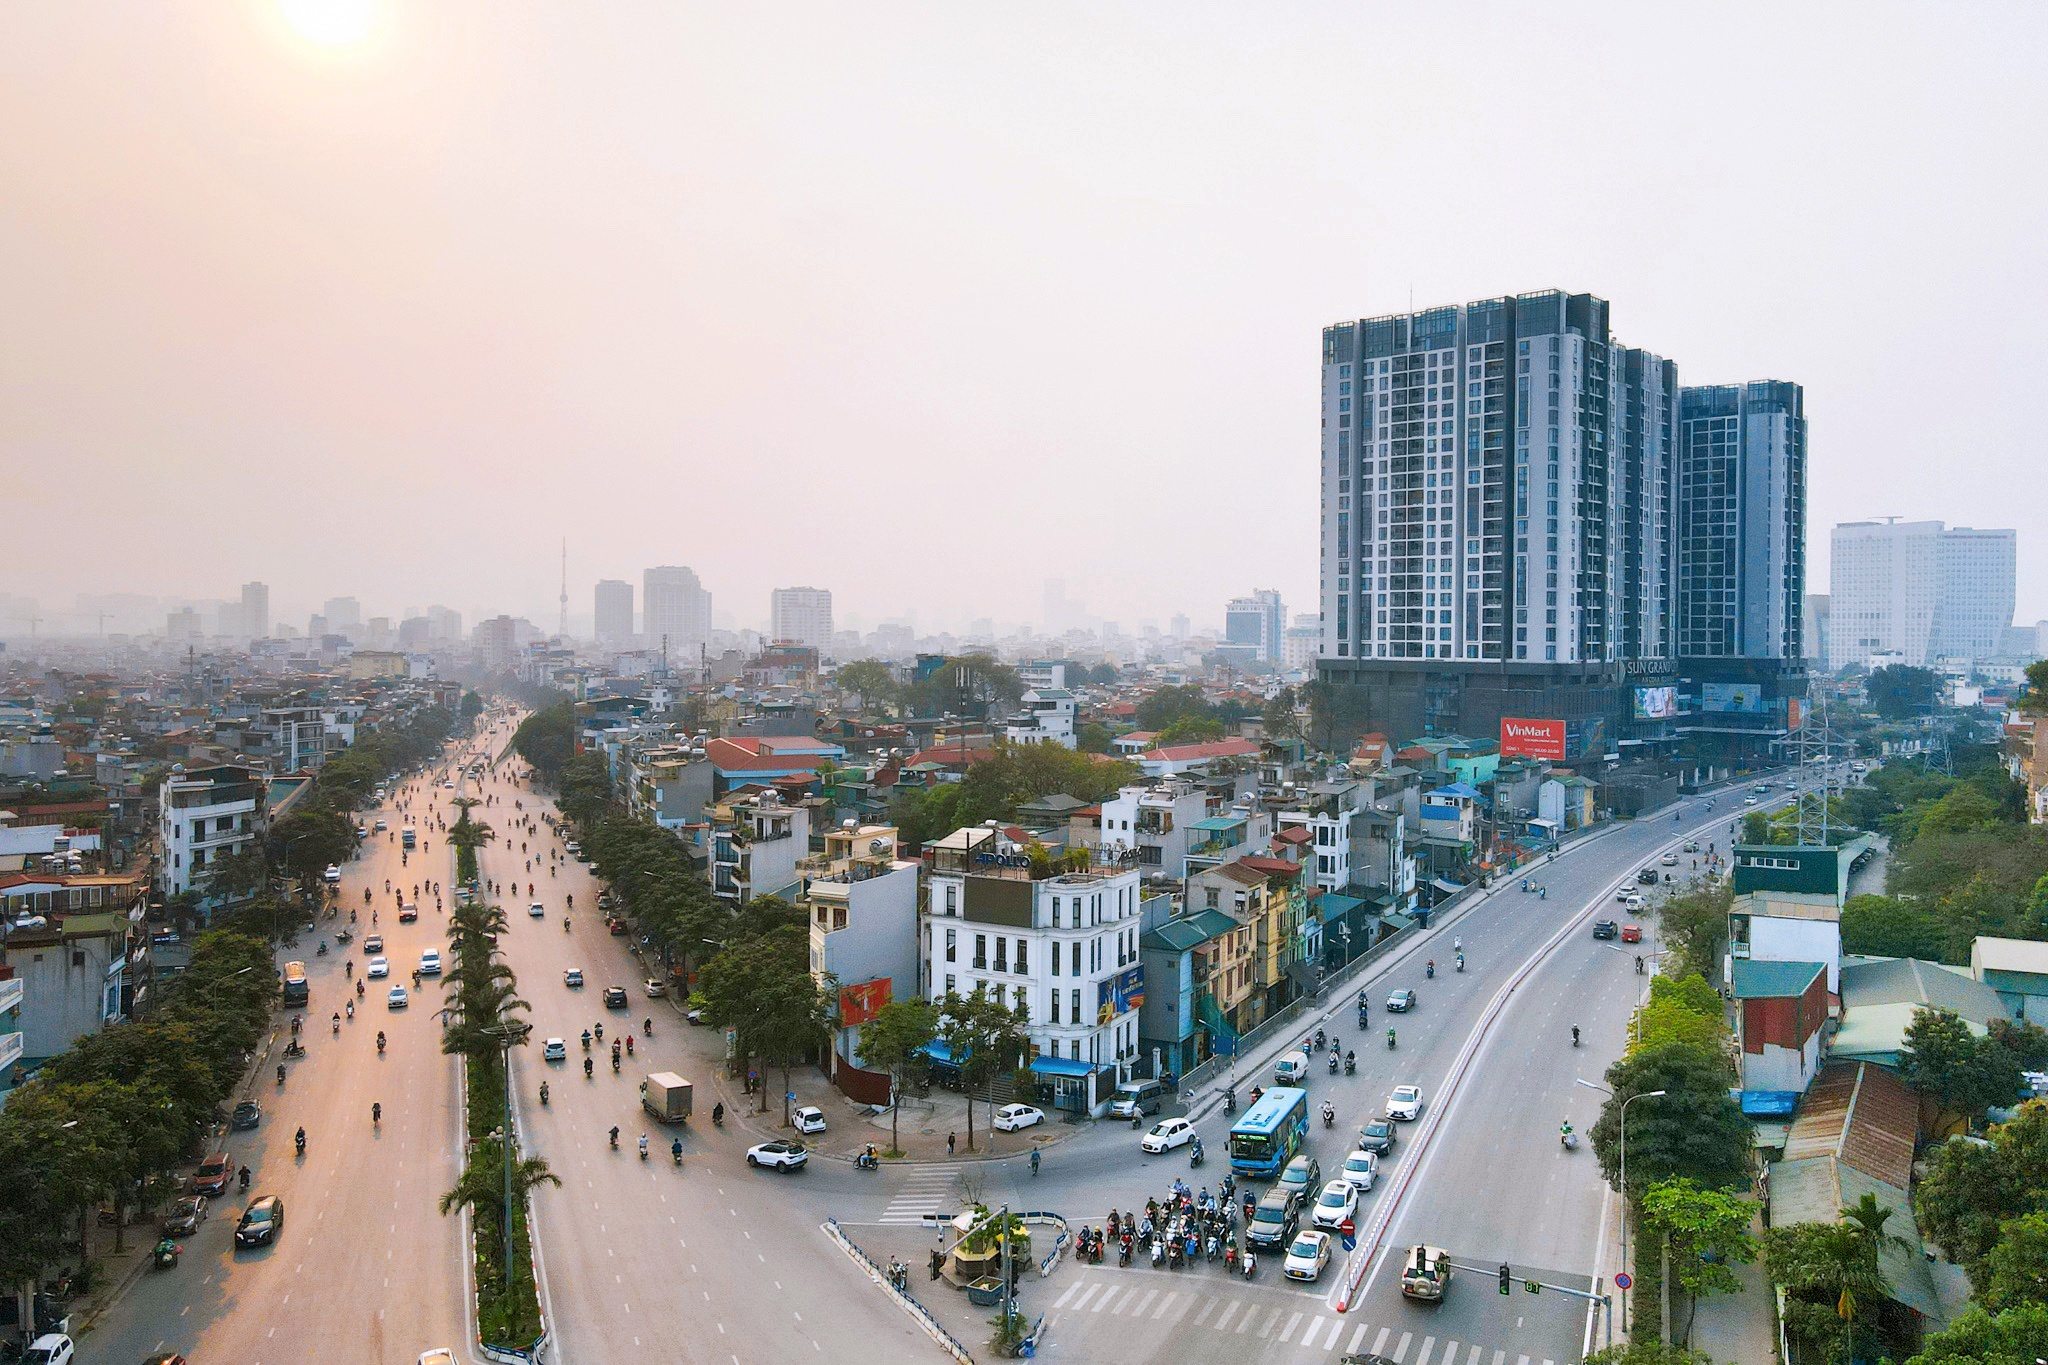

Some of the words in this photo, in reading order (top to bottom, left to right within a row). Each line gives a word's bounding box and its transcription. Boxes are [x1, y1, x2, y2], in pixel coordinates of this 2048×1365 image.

[1627, 661, 1647, 673] SUN
[1648, 661, 1670, 673] GRAND
[1505, 723, 1551, 737] VinMart
[975, 852, 1032, 869] APOLLO
